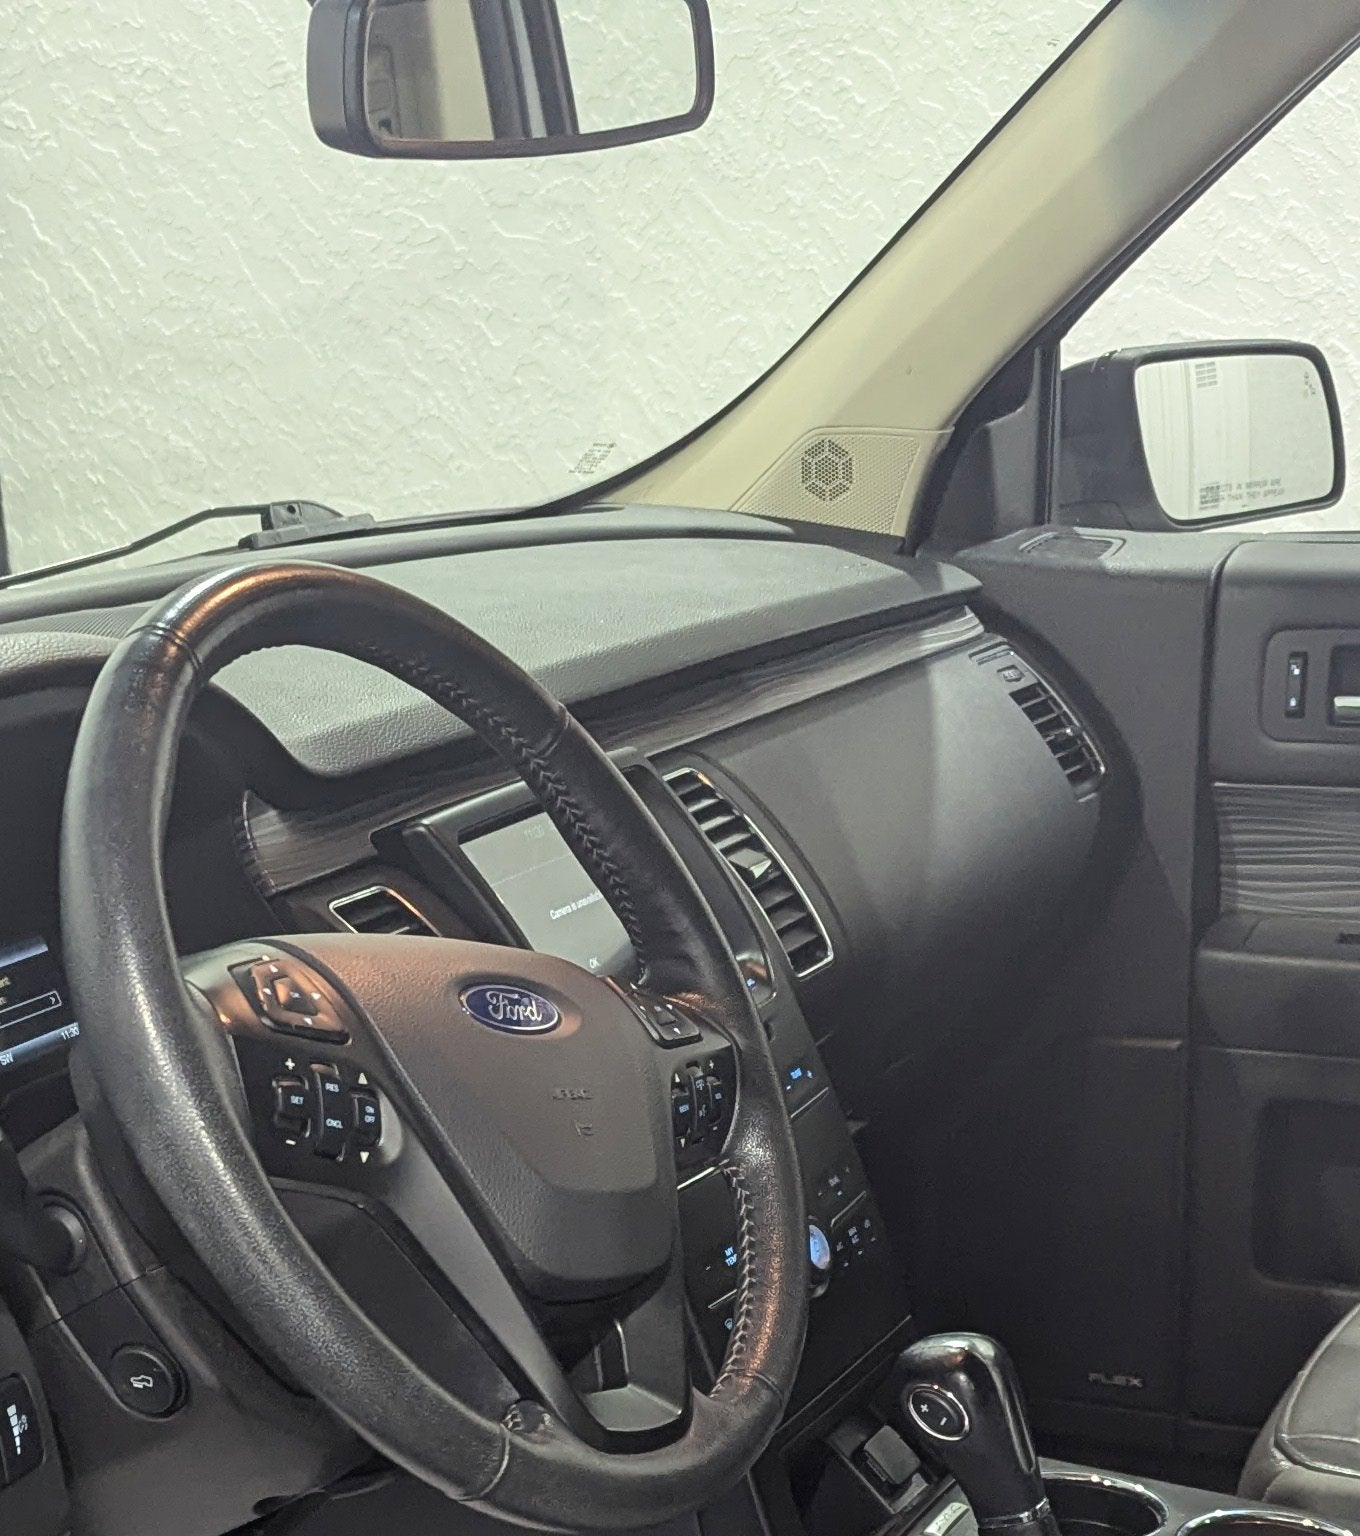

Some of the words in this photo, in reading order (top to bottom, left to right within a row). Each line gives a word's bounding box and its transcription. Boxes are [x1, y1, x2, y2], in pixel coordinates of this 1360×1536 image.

[590, 957, 600, 969] OK
[485, 990, 543, 1021] Ford
[1087, 1372, 1143, 1388] FLEX
